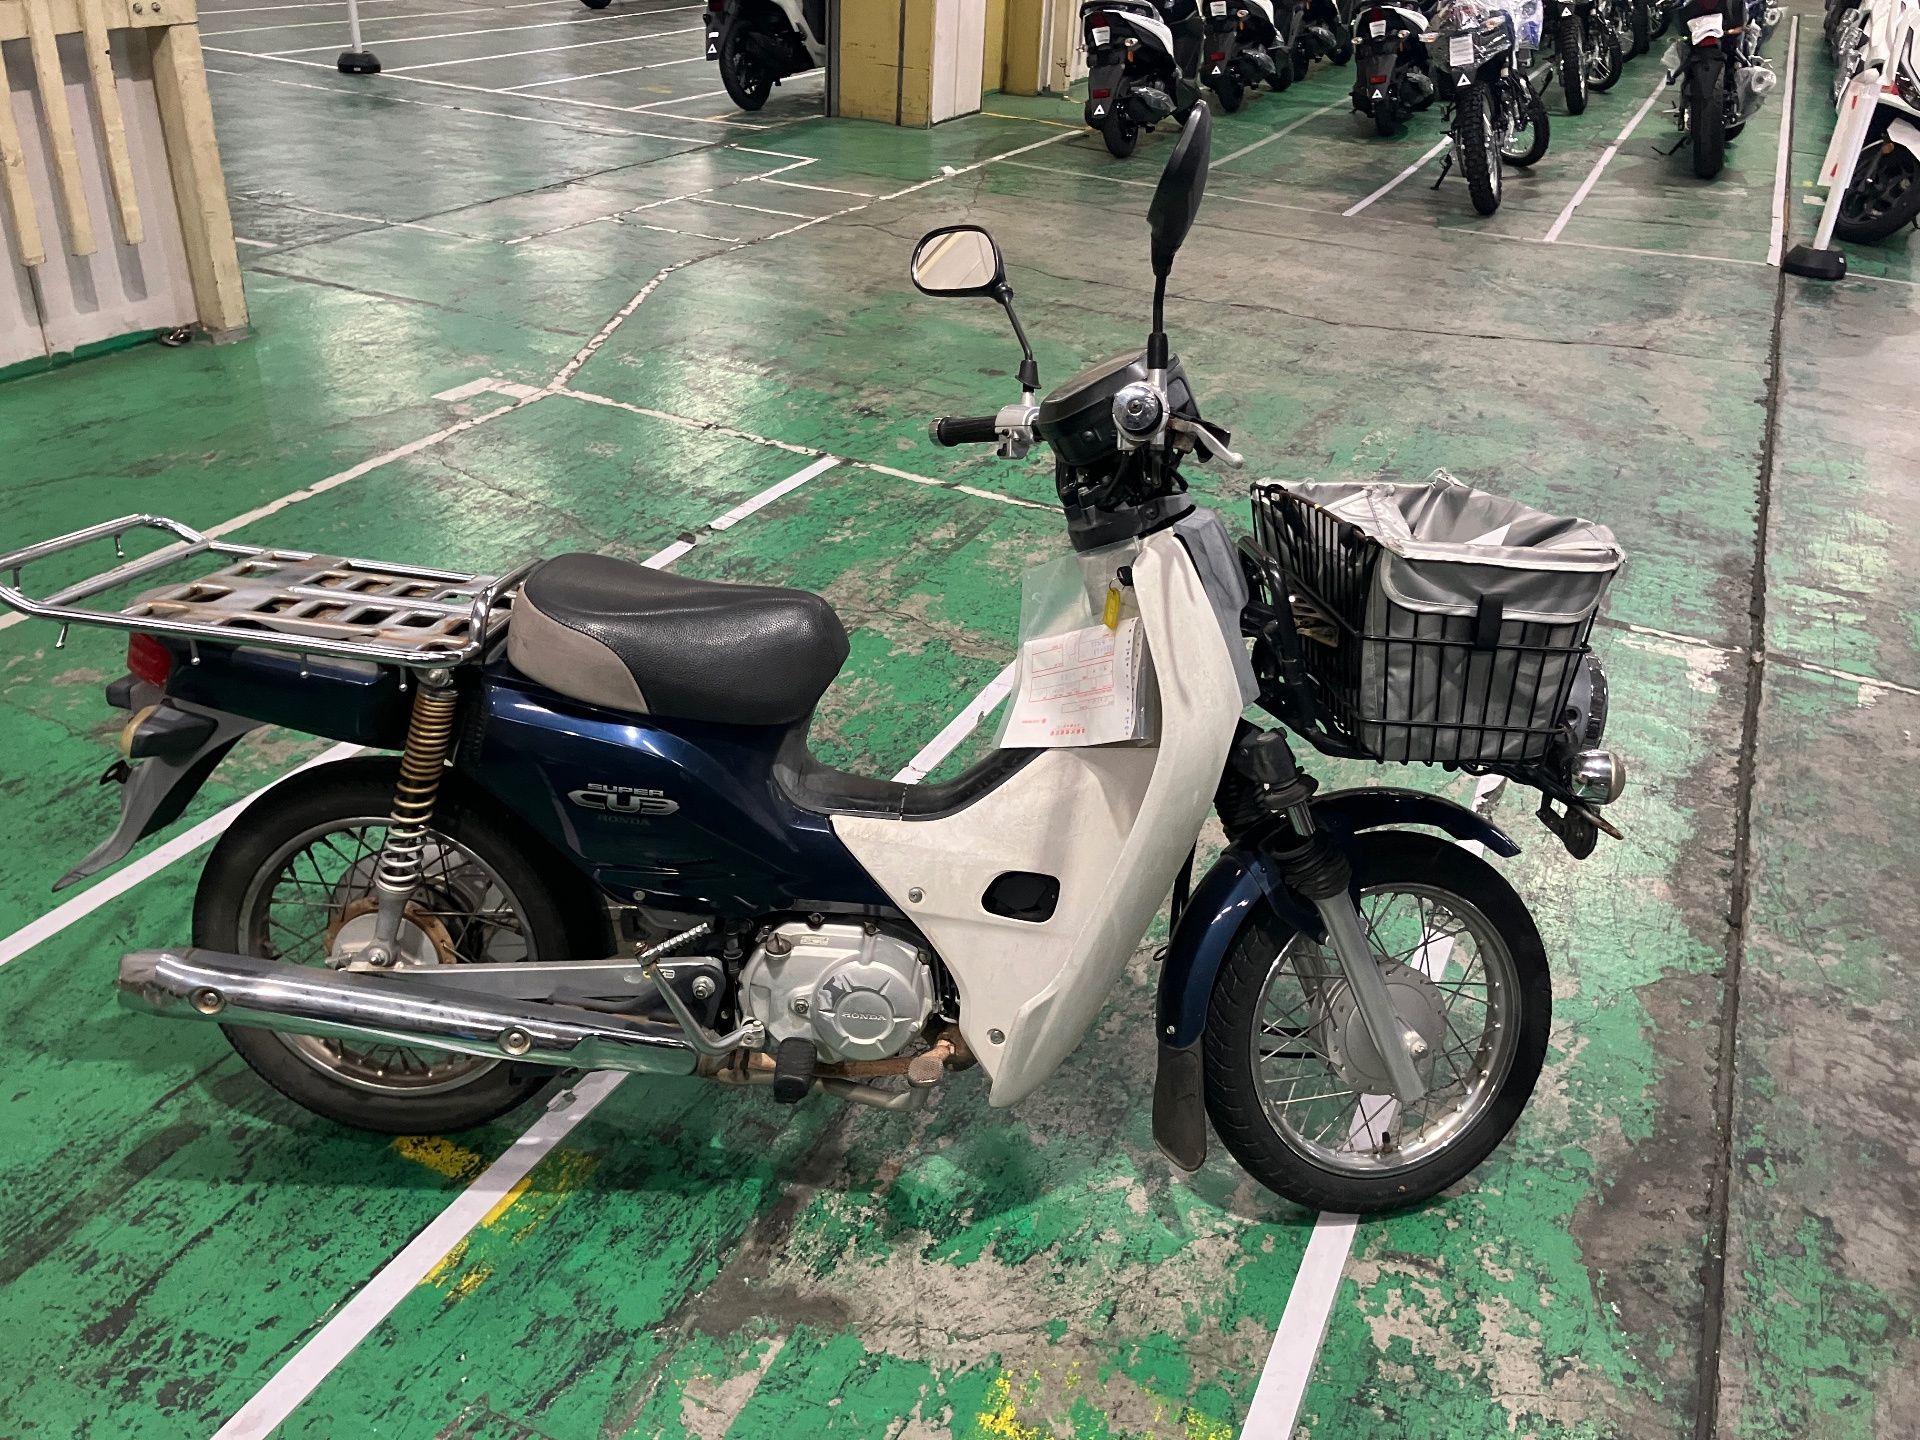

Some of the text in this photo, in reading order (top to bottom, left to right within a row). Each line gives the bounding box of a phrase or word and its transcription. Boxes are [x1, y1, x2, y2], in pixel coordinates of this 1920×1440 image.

[587, 783, 664, 797] SUPER
[567, 789, 680, 815] CUB
[841, 1012, 887, 1021] HONDA
